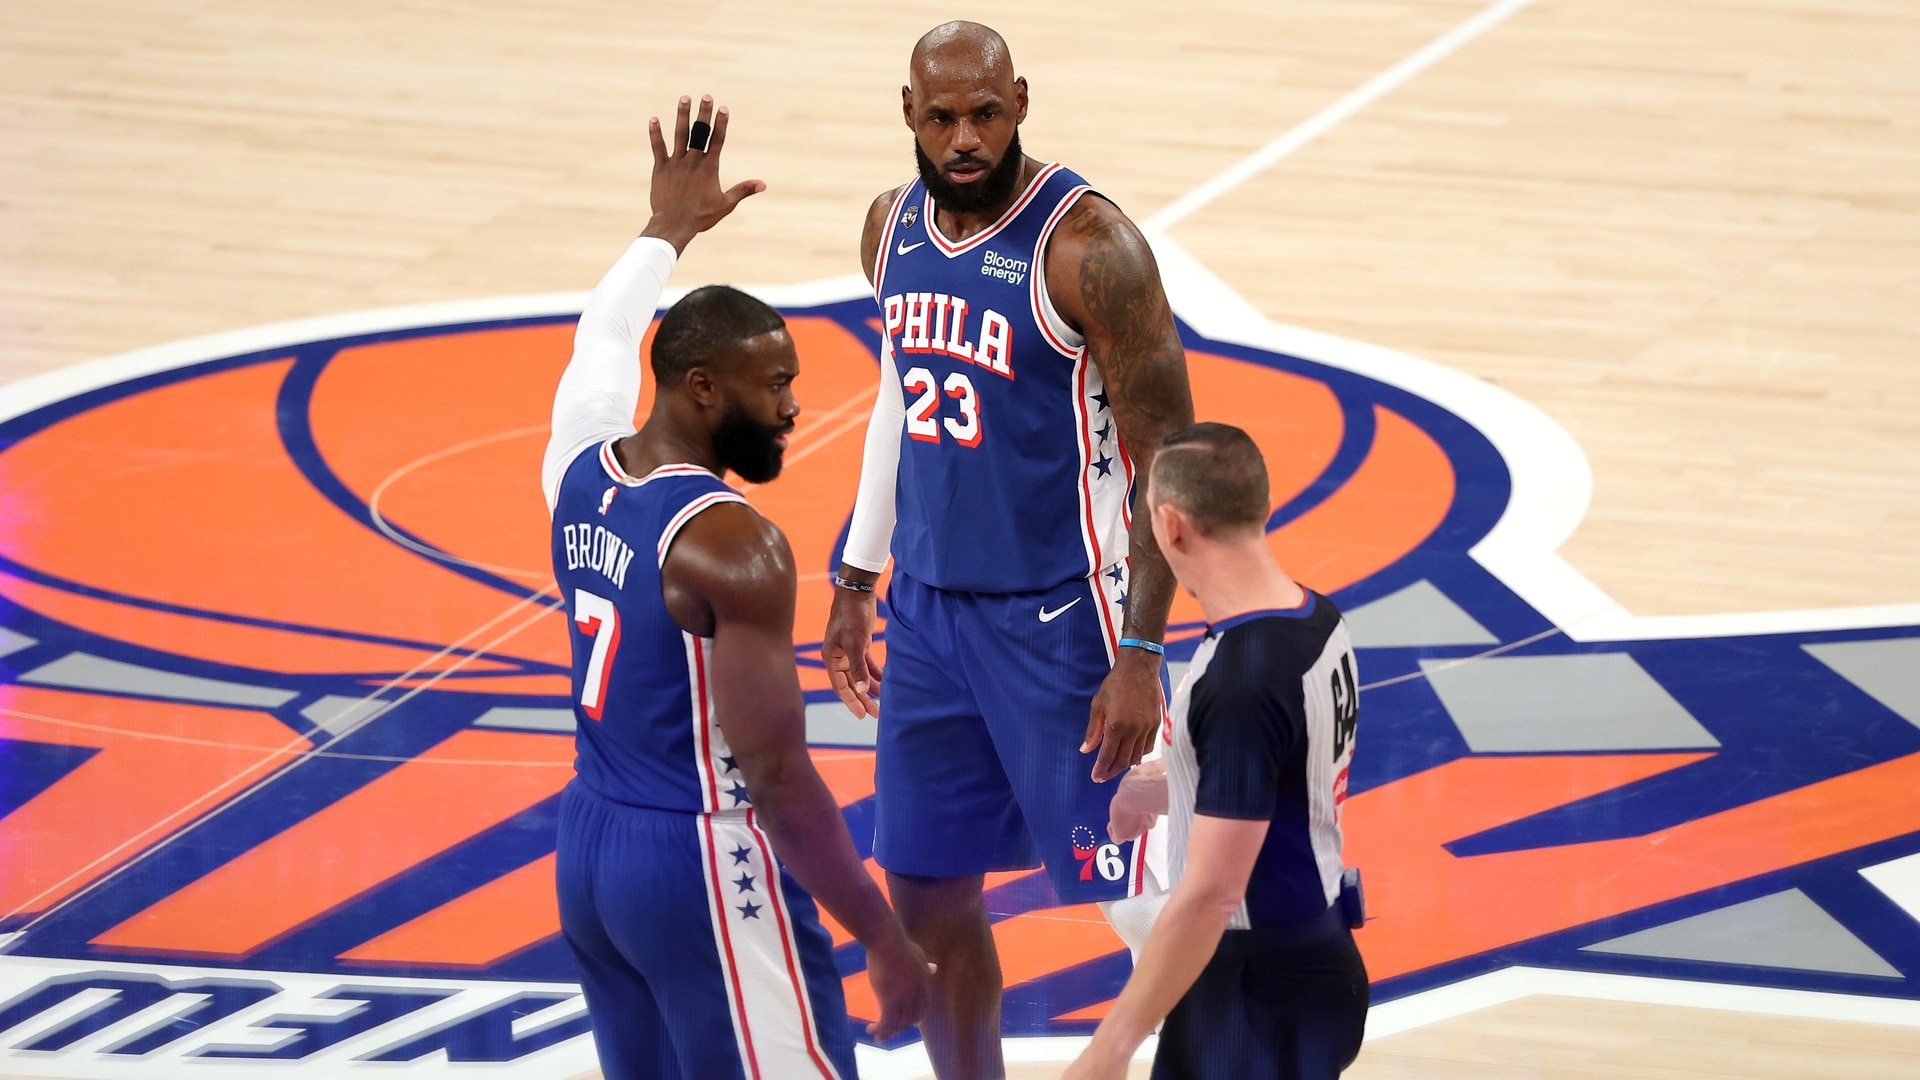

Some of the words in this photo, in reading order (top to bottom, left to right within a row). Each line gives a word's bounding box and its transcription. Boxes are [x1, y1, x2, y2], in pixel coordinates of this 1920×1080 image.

[980, 264, 1025, 286] energy
[983, 250, 1028, 273] Bloom
[884, 292, 1015, 381] PHILA
[903, 366, 983, 449] 23
[563, 522, 635, 591] BROWN
[574, 587, 622, 722] 7
[1331, 652, 1358, 764] 64
[1072, 843, 1125, 881] 76
